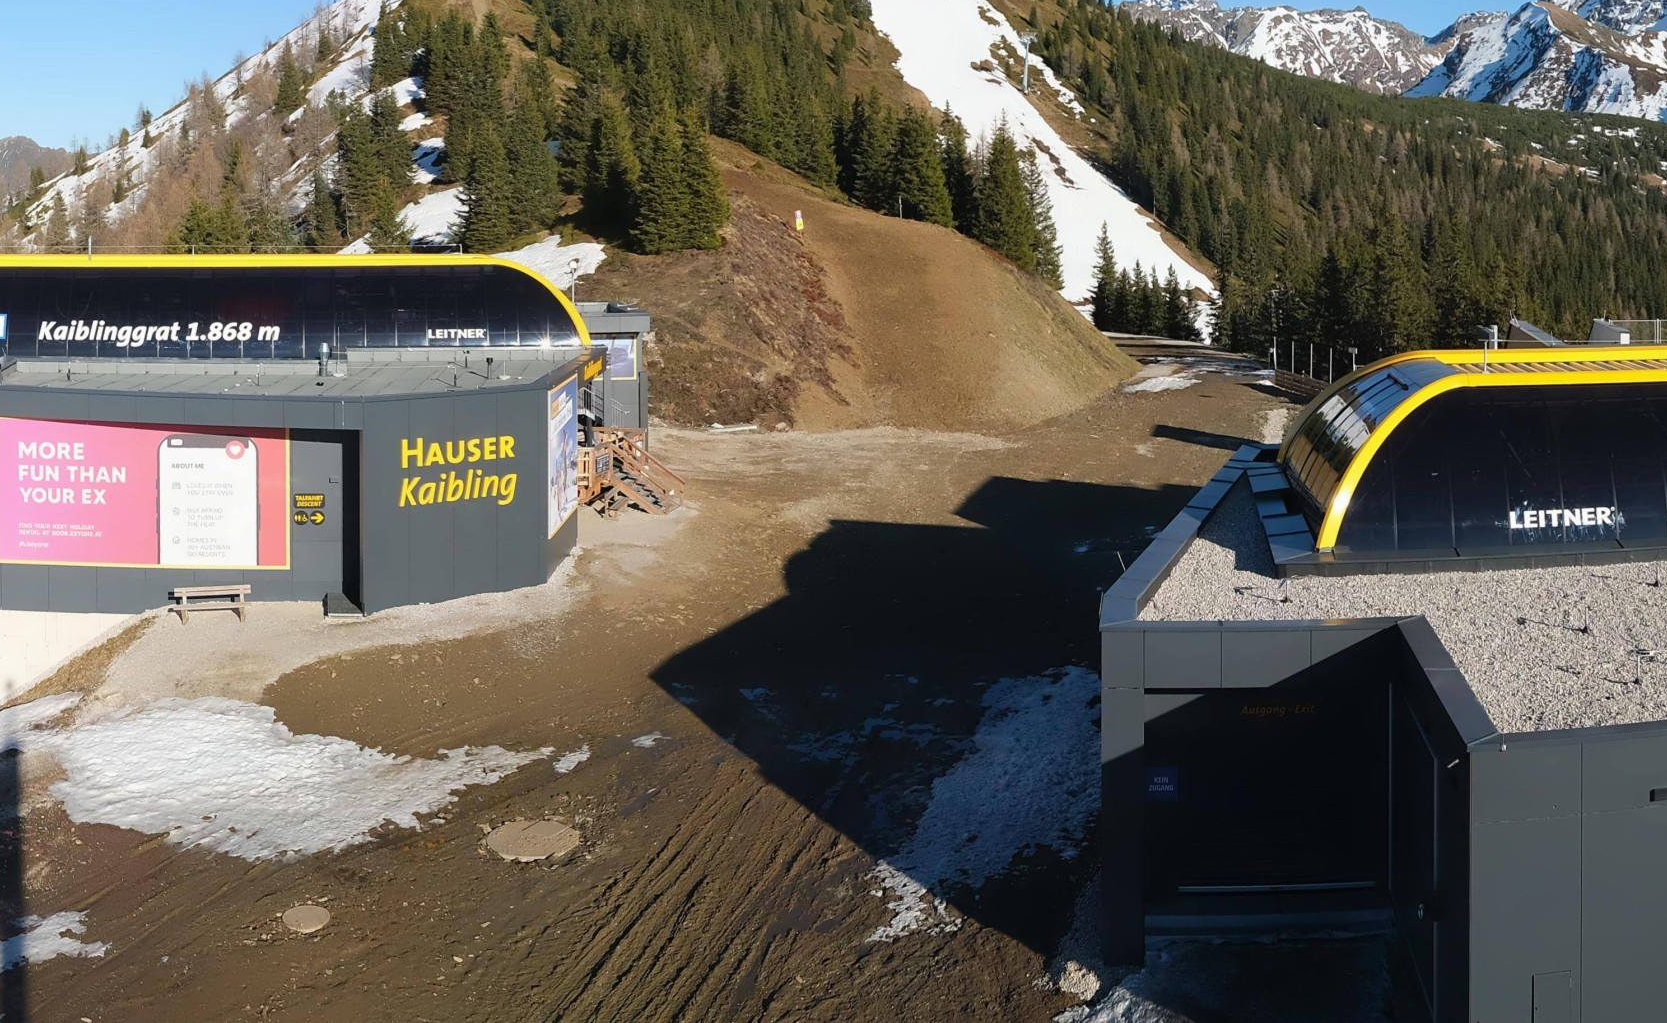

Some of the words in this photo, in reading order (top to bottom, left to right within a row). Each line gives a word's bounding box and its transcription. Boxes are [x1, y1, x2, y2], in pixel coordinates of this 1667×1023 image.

[38, 320, 180, 347] Kaiblinggrat
[185, 321, 252, 342] 1.868
[257, 325, 280, 342] m
[427, 328, 486, 339] LEITNER
[18, 441, 85, 460] MORE
[401, 435, 516, 469] HAUSER
[18, 464, 60, 482] FUN
[66, 465, 127, 483] THAN
[19, 487, 75, 503] YOUR
[81, 488, 107, 505] EX
[398, 468, 518, 507] Kaibling
[1509, 506, 1616, 529] LEITNER
[1240, 704, 1287, 716] Ausgang
[1294, 704, 1316, 714] Exit
[1148, 784, 1174, 792] ZUGANG
[1153, 776, 1169, 784] KEIN
